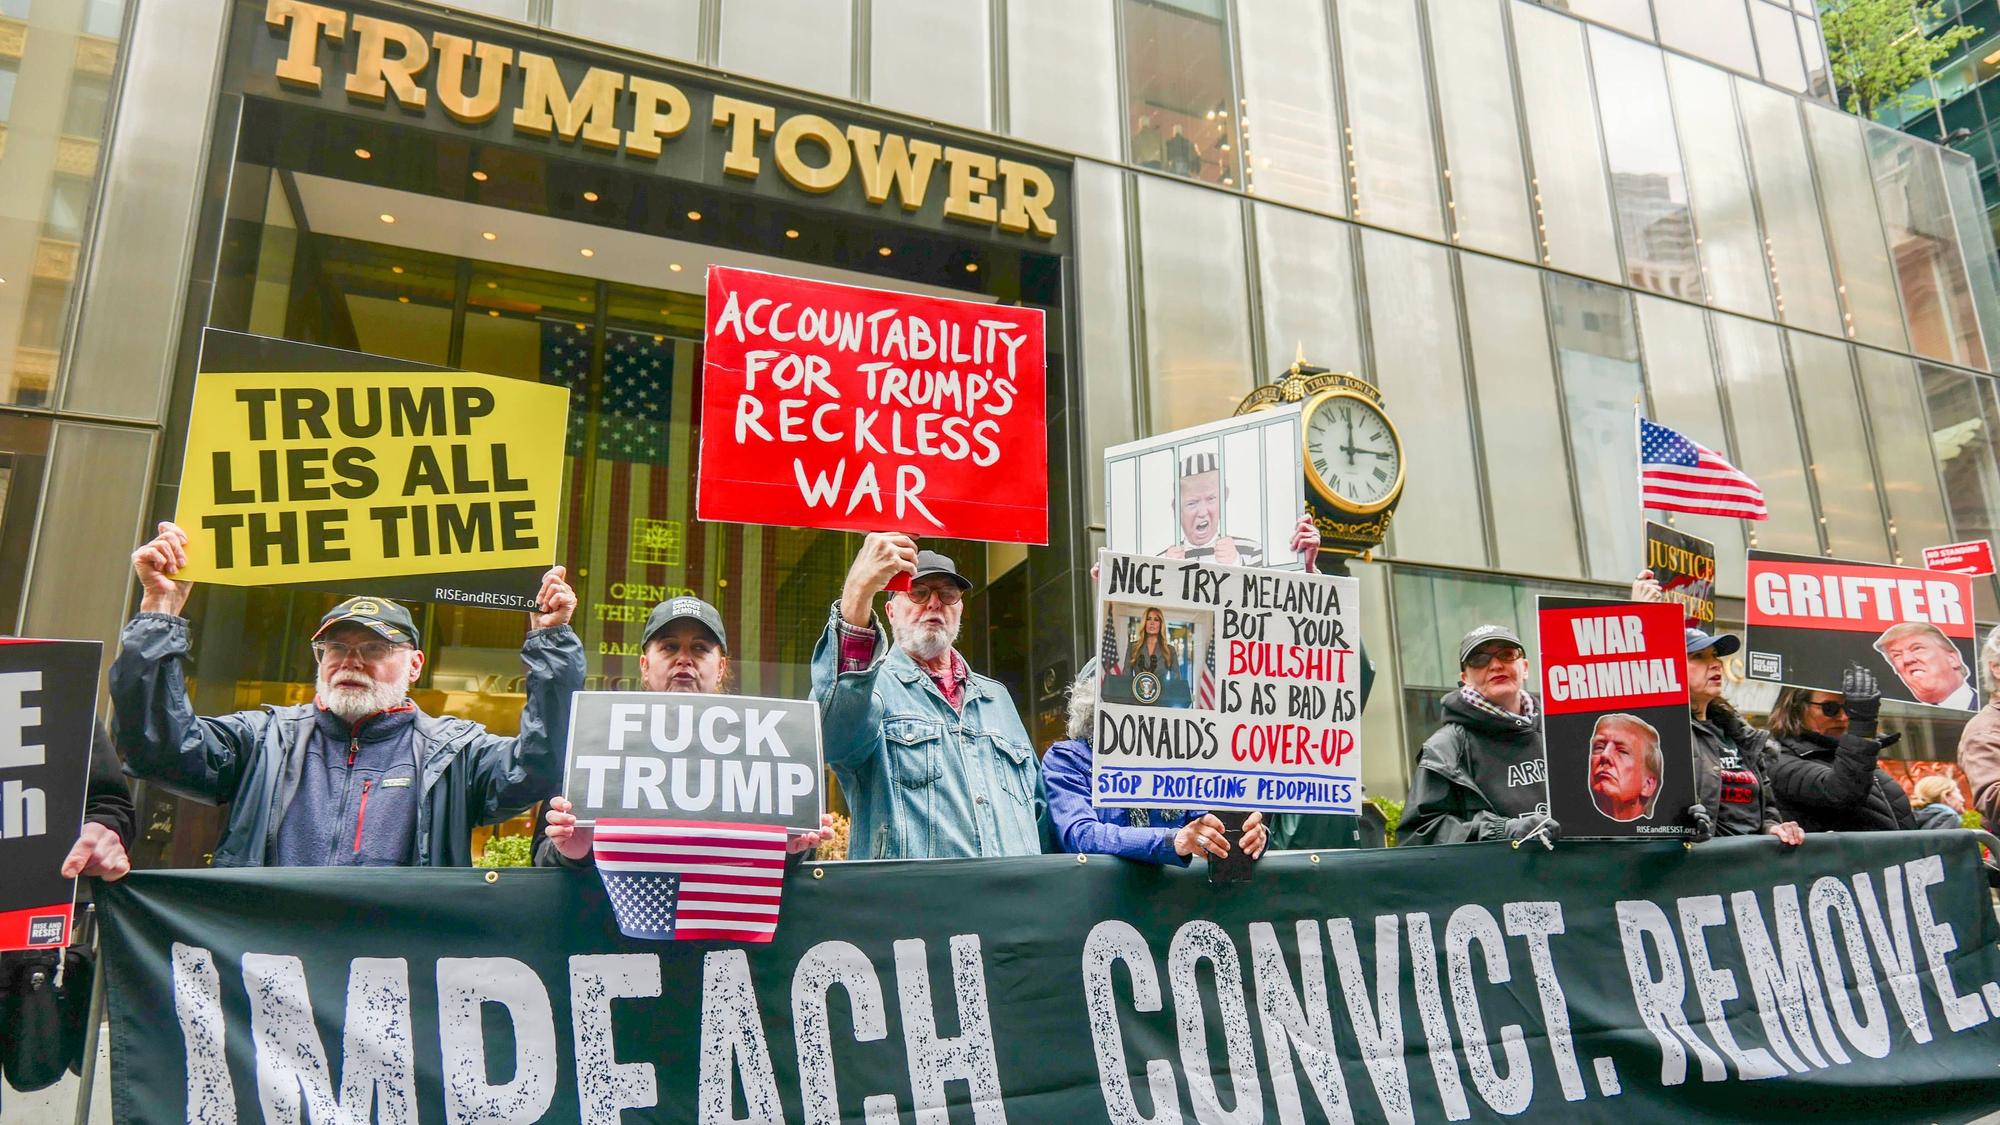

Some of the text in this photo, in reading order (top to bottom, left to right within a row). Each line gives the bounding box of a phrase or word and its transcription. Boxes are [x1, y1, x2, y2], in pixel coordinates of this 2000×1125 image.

[266, 0, 1056, 237] TRUMP TOWER
[715, 291, 1027, 380] ACCOUNTABILITY
[745, 350, 1018, 418] FOR TRUMP'S
[1308, 375, 1378, 399] TRUMP TOWER
[235, 387, 495, 441] TRUMP
[735, 394, 1000, 467] RECKLESS
[212, 443, 528, 505] LIES ALL
[793, 457, 945, 528] WAR
[202, 500, 539, 569] THE TIME
[1926, 544, 1980, 559] NO STANDING
[1648, 538, 1714, 584] JUSTICE
[1929, 556, 1963, 566] Anytime
[435, 587, 539, 609] RISEandRESIST.or
[610, 583, 665, 602] OPEN
[1108, 556, 1341, 615] NICE TRY, MELANIA
[1661, 589, 1714, 622] ATTERS
[1754, 571, 1965, 625] GRIFTER
[594, 603, 636, 622] THE
[1222, 609, 1351, 650] BUT YOUR
[599, 642, 639, 656] 8AM
[1571, 615, 1646, 656] WAR
[1228, 640, 1355, 683] BULLSHIT
[1548, 657, 1682, 702] CRIMINAL
[1220, 679, 1356, 723] IS AS BAD AS
[608, 703, 791, 758] FUCK
[1097, 709, 1219, 760] DONALD'S
[1231, 724, 1355, 767] COVER-UP
[575, 755, 815, 816] TRUMP
[1097, 771, 1352, 804] STOP PROTECTING PEDOPHILES
[1636, 825, 1696, 836] RISEandRESIST.org
[31, 928, 60, 938] RESIST
[32, 921, 62, 930] RISE AND
[170, 854, 2000, 1125] IMPEACH CONVICT. REMOVE.
